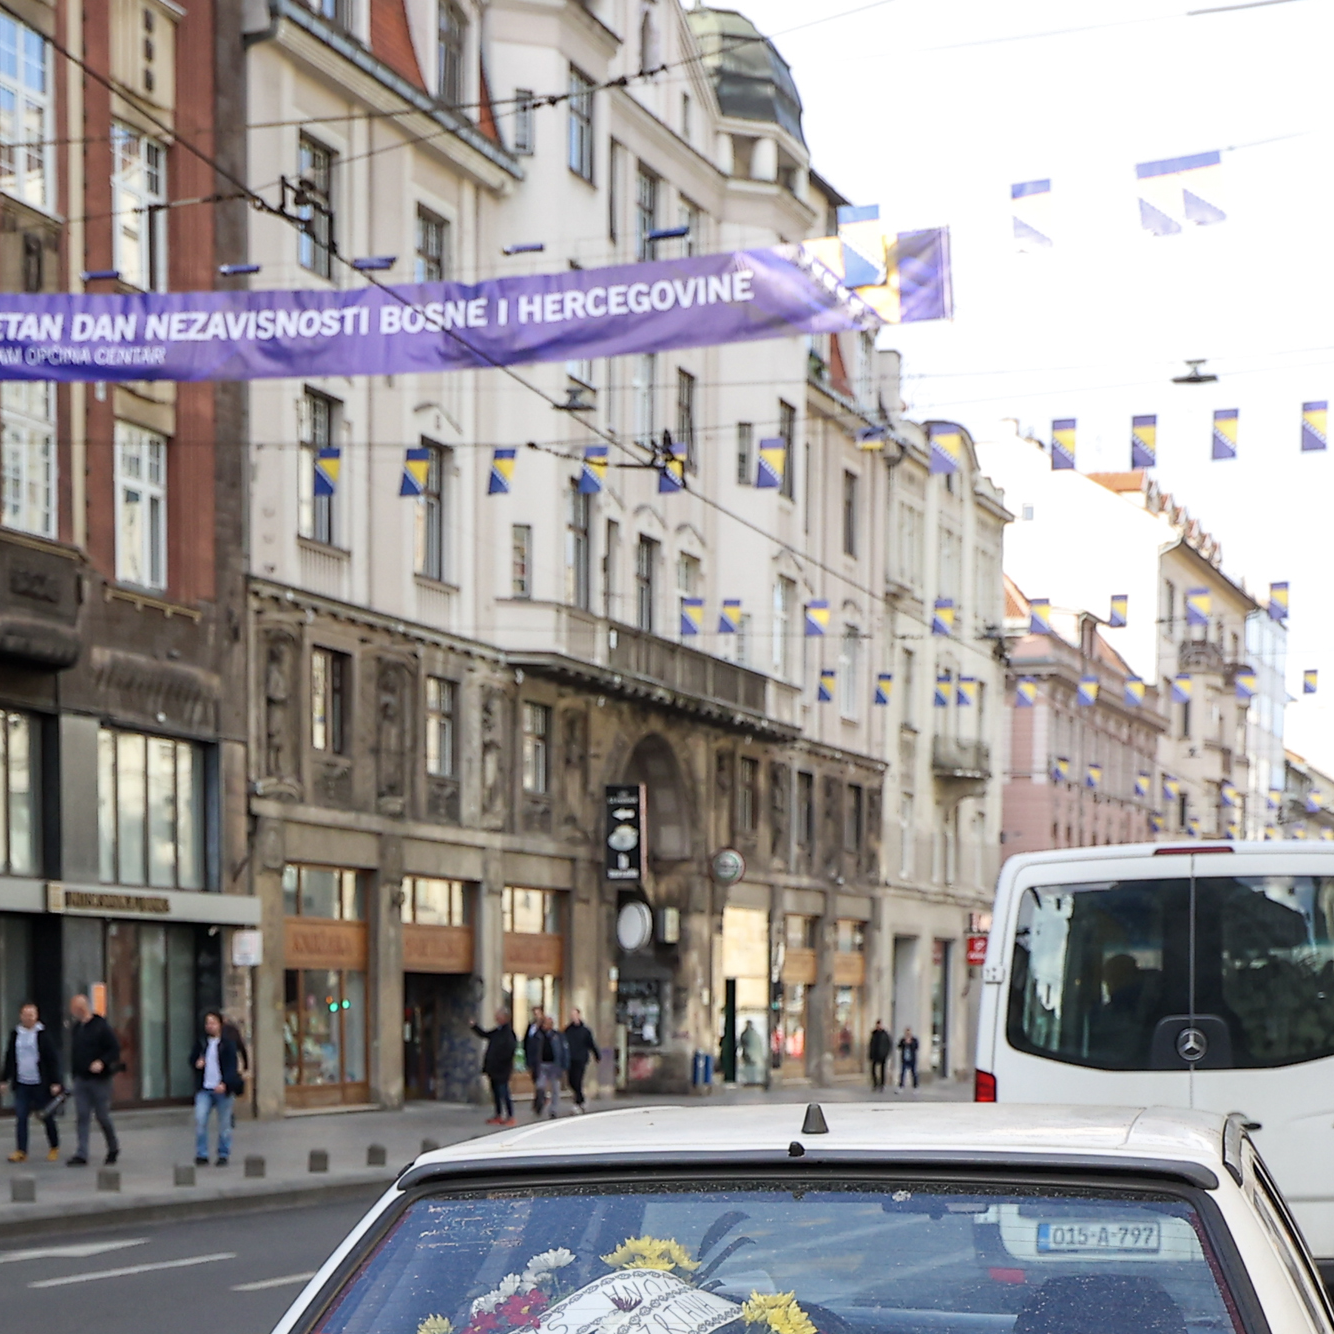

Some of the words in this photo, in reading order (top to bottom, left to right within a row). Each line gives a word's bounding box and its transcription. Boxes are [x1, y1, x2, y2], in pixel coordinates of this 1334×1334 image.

[70, 311, 138, 343] DAN
[144, 305, 369, 342] NEZAVISNOSTI
[378, 297, 489, 335] BOSNE
[496, 298, 510, 327] I
[517, 269, 755, 324] HERCEGOVINE
[92, 346, 166, 366] CENTAR
[1052, 1226, 1155, 1246] 015-A-797
